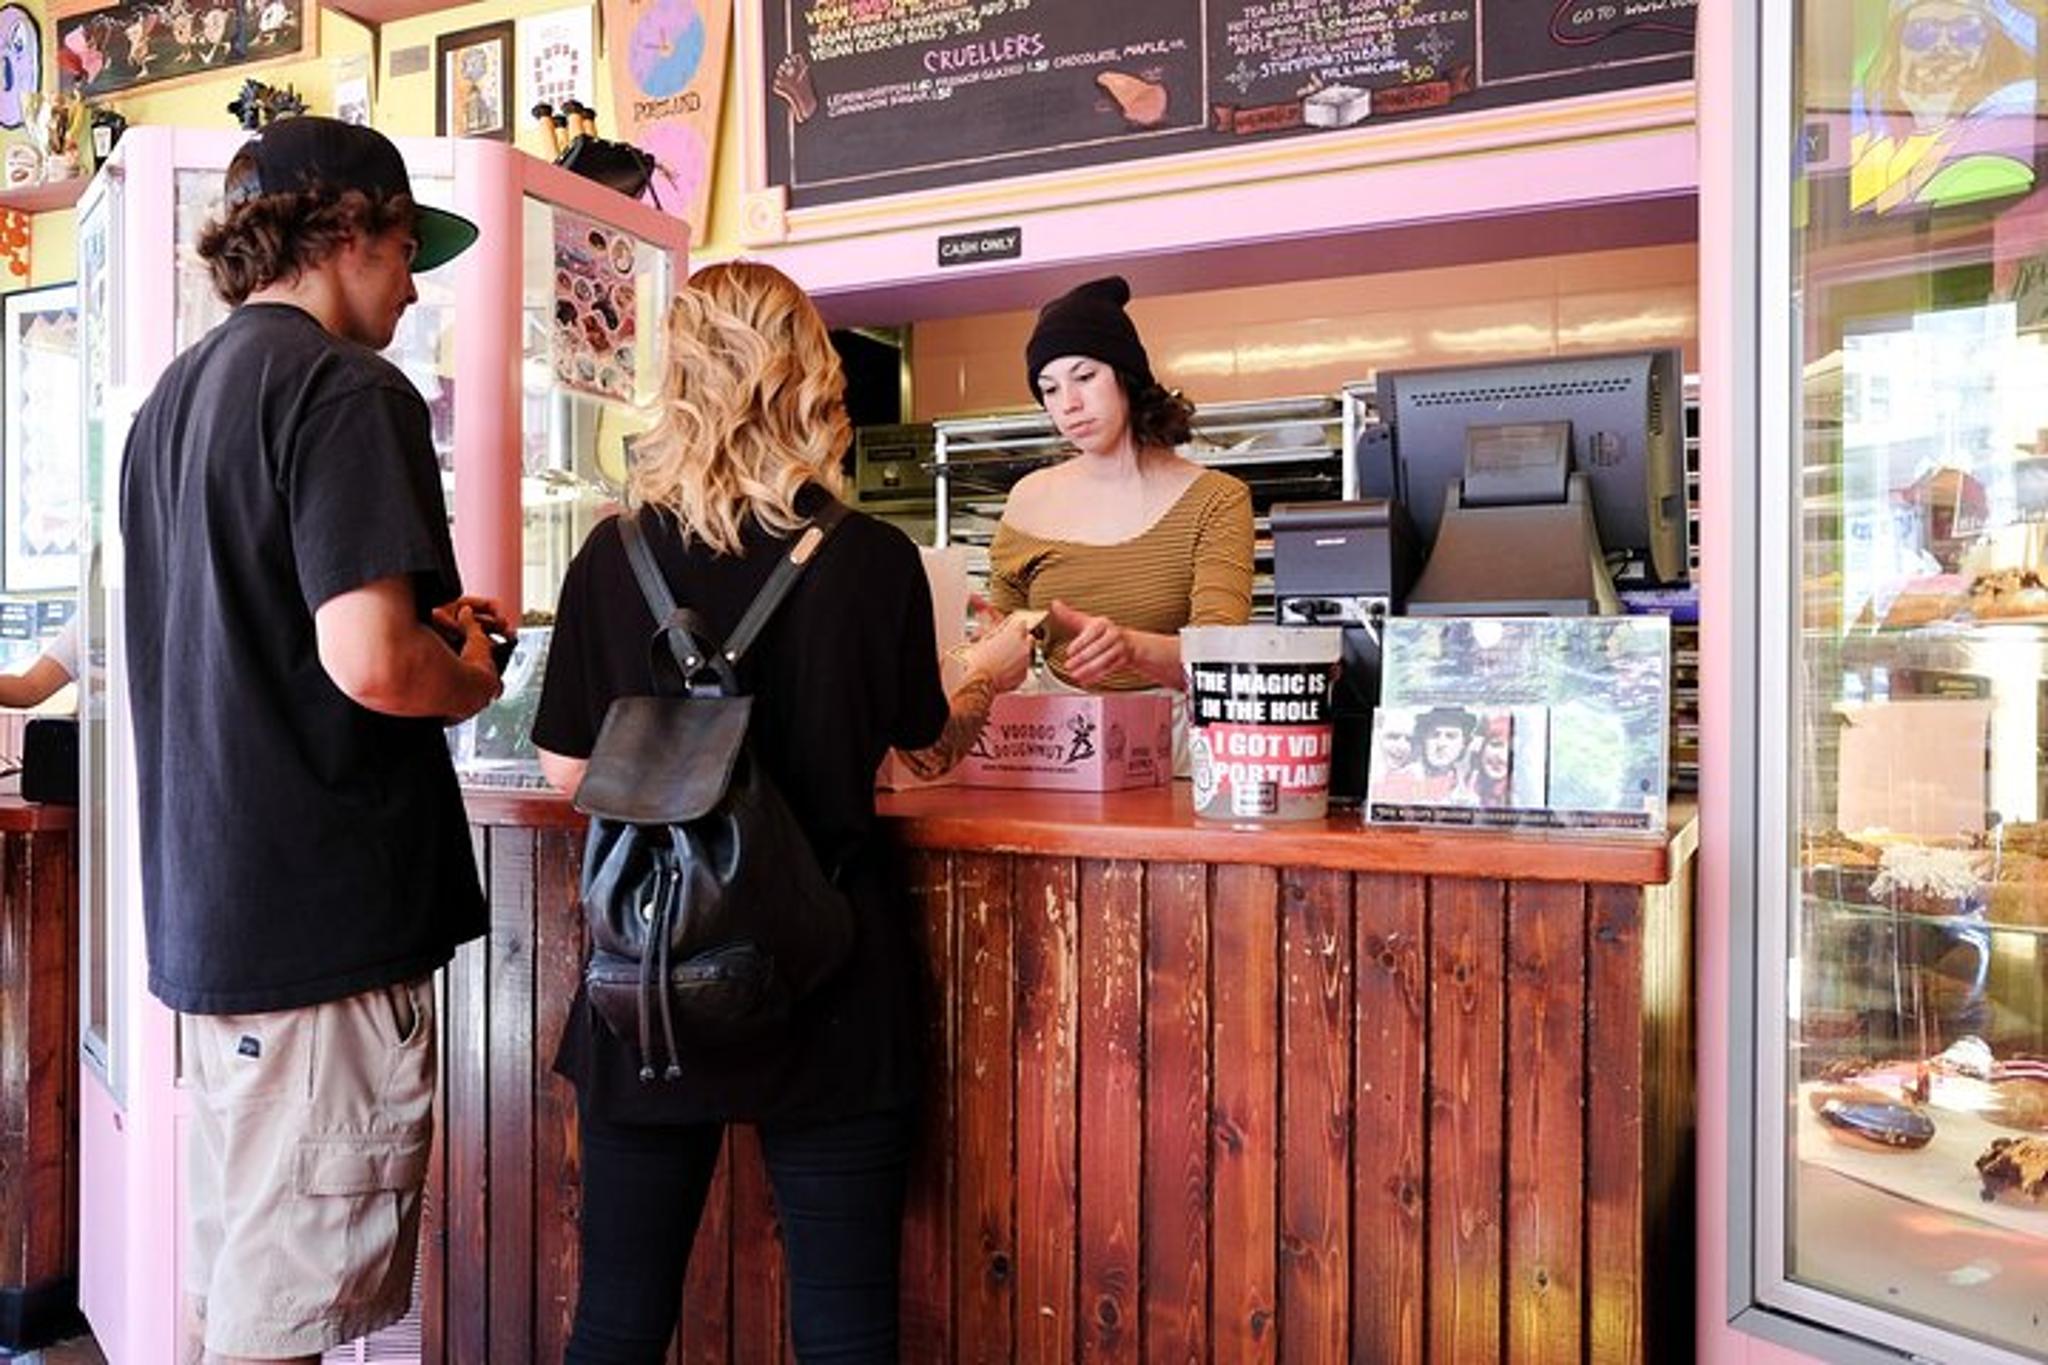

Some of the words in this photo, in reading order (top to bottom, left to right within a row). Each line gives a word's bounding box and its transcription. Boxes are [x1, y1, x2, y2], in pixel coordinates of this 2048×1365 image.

[1572, 9, 1595, 25] GO
[1597, 5, 1617, 21] TO
[923, 33, 1045, 73] CRUELLERS
[941, 239, 979, 257] CASH
[980, 235, 1017, 252] ONLY
[1195, 671, 1227, 693] THE
[1231, 672, 1306, 695] MAGIC
[1308, 673, 1326, 694] IS
[1202, 698, 1222, 718] IN
[1224, 700, 1267, 721] THE
[1270, 701, 1320, 721] HOLE
[1000, 724, 1057, 742] VOODOO
[1214, 731, 1224, 755] I
[1228, 732, 1284, 757] GOT
[1287, 735, 1318, 758] VD
